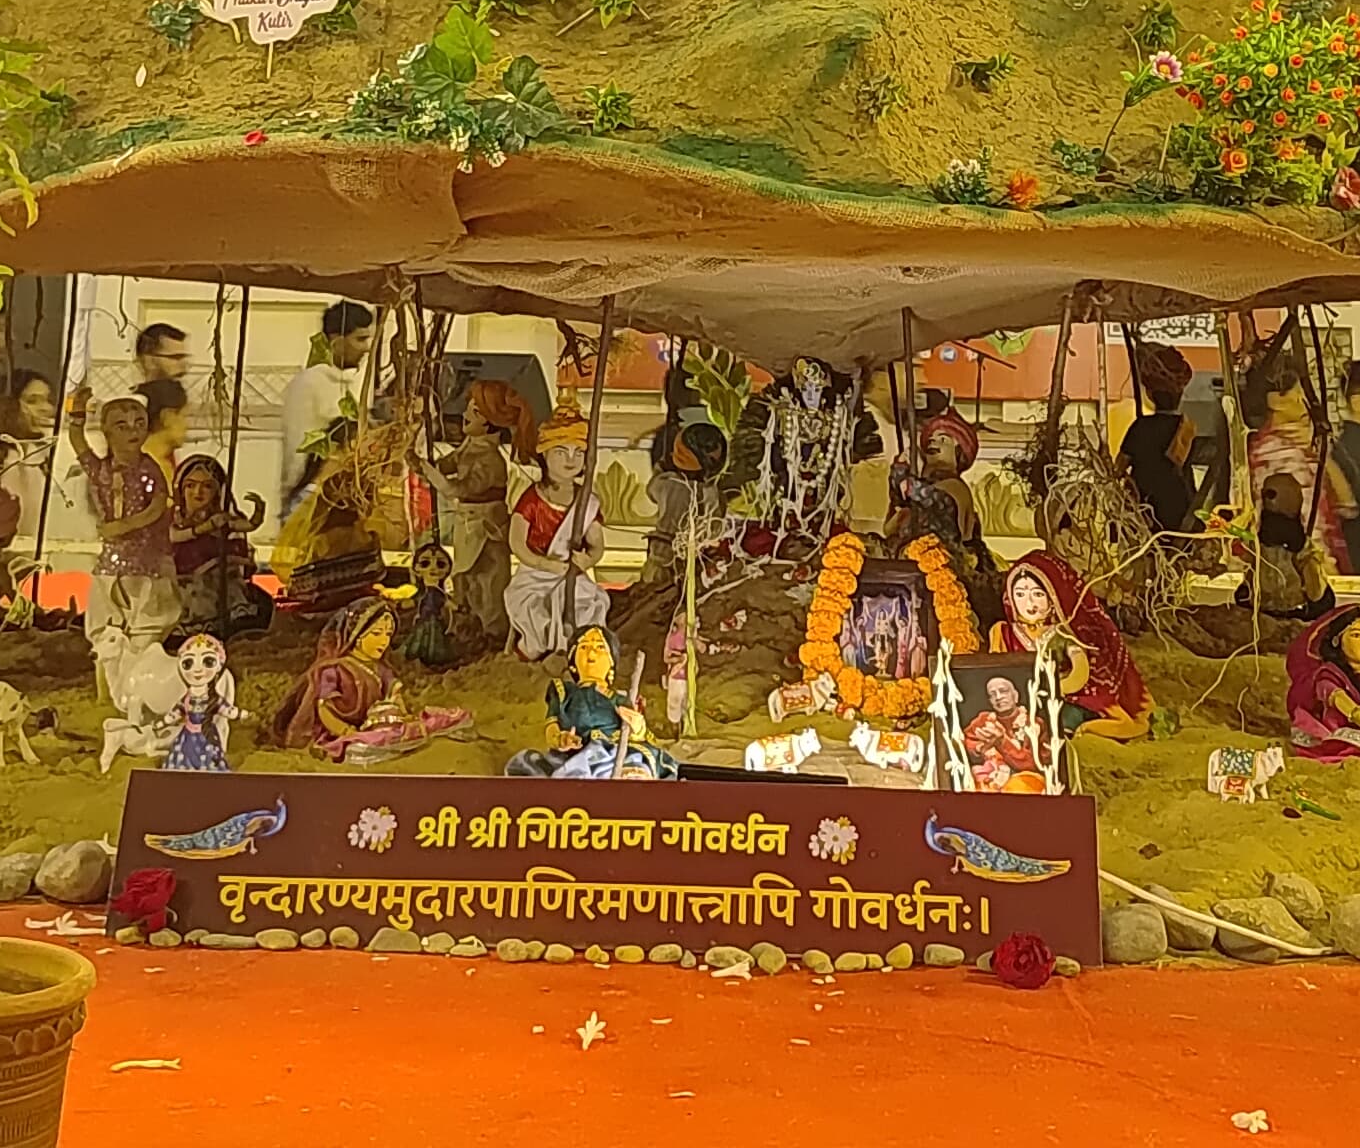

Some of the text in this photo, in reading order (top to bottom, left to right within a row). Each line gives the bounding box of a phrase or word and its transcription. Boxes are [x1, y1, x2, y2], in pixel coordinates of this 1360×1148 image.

[257, 10, 294, 33] Kutir
[415, 806, 790, 856] श्री श्री गिरिराज गोवर्धन
